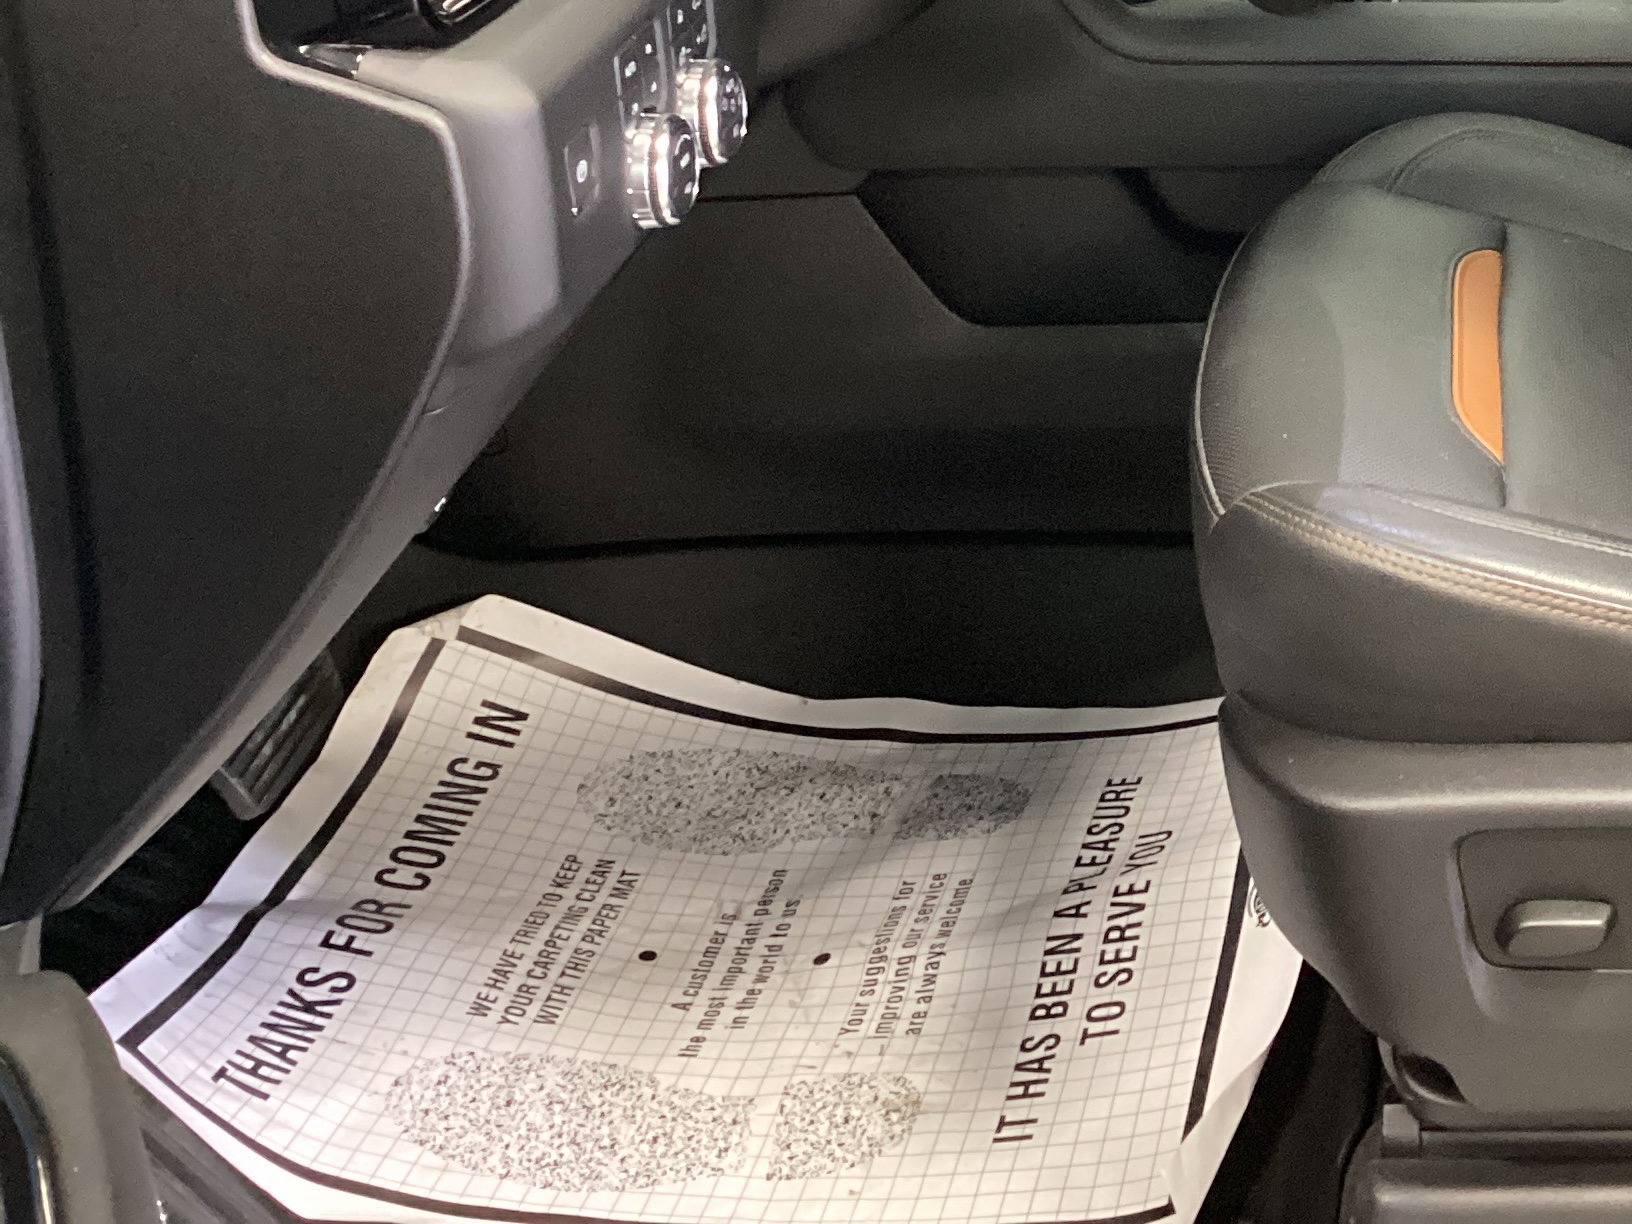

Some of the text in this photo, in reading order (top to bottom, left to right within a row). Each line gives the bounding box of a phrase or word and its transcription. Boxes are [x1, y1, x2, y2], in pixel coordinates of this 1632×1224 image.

[212, 699, 530, 1101] THANKS FOR COMING IN
[466, 854, 584, 1018] WE HAVE TRIED TO KEEP
[497, 859, 616, 1026] YOUR CARPETING CLEAN
[533, 870, 642, 1025] WITH THIS PAPER MAT
[671, 913, 737, 1011] A customer is
[678, 869, 789, 1058] the most important person
[752, 944, 784, 984] world
[769, 922, 791, 937] to
[838, 880, 917, 1036] Your suggestions for
[867, 873, 948, 1039] improving our service
[915, 942, 947, 1004] always
[992, 776, 1143, 1144] IT HAS BEEN A PLEASURE
[1079, 829, 1174, 1046] TO SERVE YOU
[724, 1016, 749, 1029] in
[735, 988, 762, 1010] the
[905, 1011, 928, 1036] are
